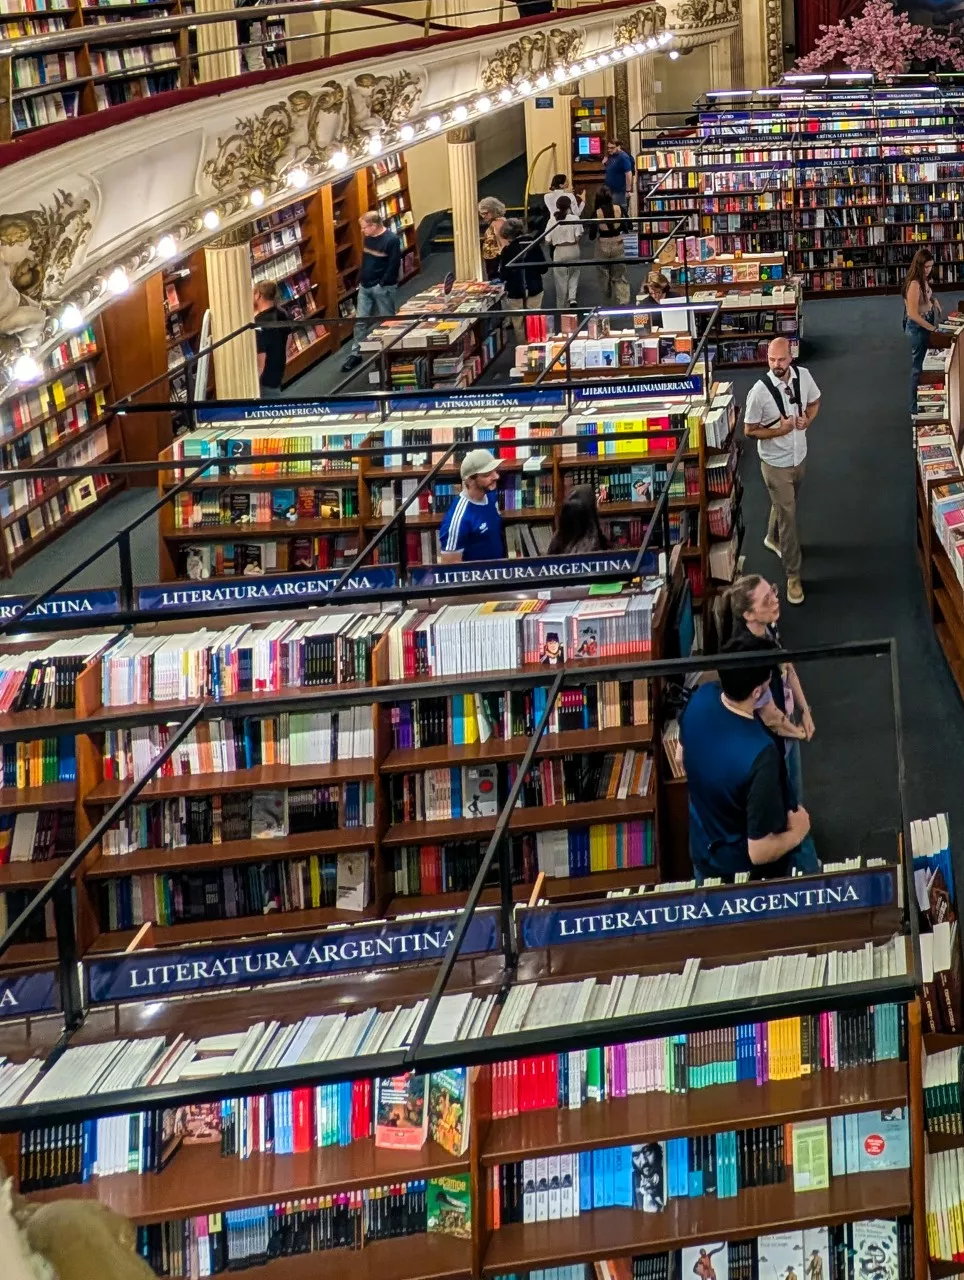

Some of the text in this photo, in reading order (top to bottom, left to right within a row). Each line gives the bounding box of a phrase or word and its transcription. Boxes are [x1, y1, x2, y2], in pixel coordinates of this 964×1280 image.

[244, 406, 331, 418] LATINOAMERICANA
[435, 398, 518, 408] LATINOAMERICANA
[435, 559, 631, 584] LITERATURA ARGENTINA
[162, 576, 371, 605] LITERATURA ARGENTNA
[559, 884, 860, 937] LITERATURA ARGENTINA
[130, 930, 455, 988] LITERATURA ARGENTINA
